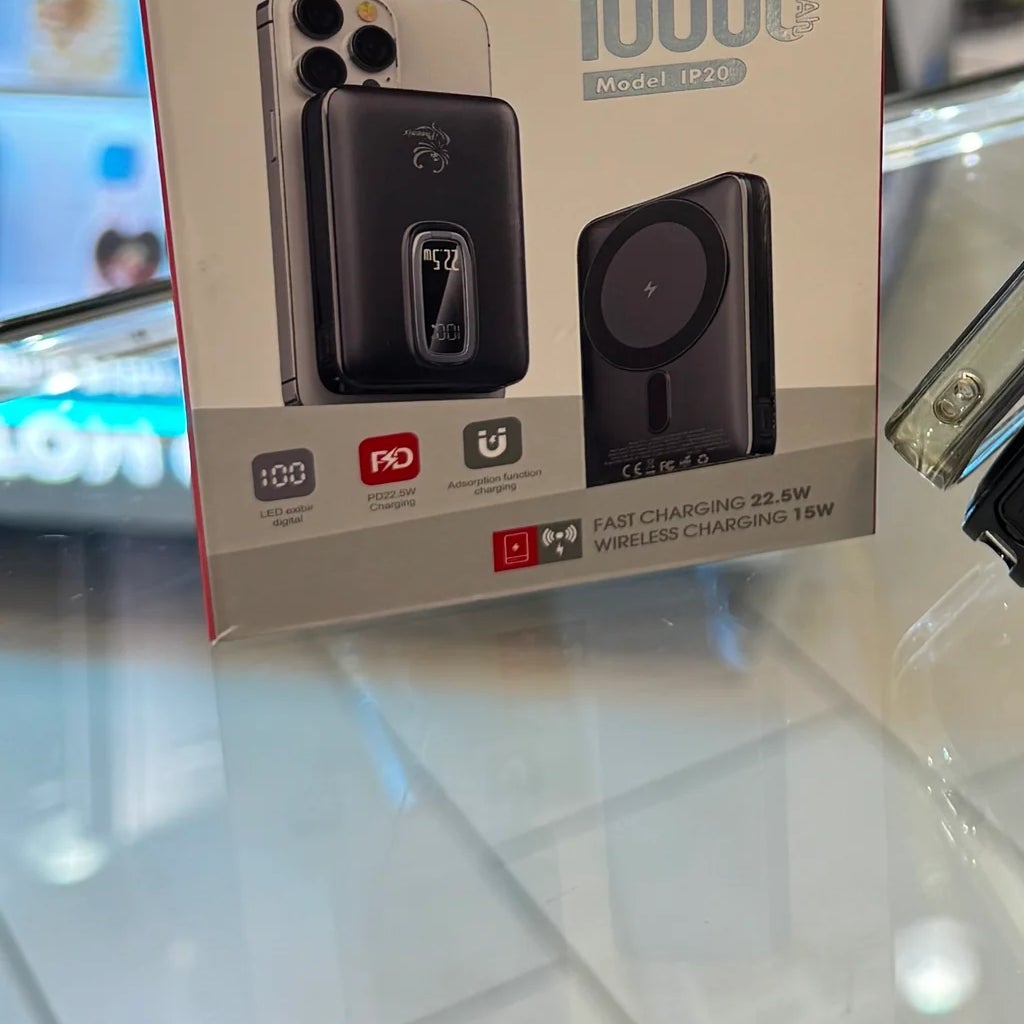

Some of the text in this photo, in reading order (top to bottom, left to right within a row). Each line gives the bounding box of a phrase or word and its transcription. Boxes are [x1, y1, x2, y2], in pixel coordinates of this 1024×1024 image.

[596, 65, 730, 95] Model IP20
[261, 461, 306, 487] 100
[447, 468, 542, 490] Adsorption function
[367, 487, 416, 502] PD22.5W
[474, 482, 517, 495] charging
[260, 507, 283, 519] LED
[369, 499, 416, 512] Charging
[593, 485, 812, 533] FAST CHARGING 22.5W
[593, 501, 836, 553] WIRELESS CHARGING 15W
